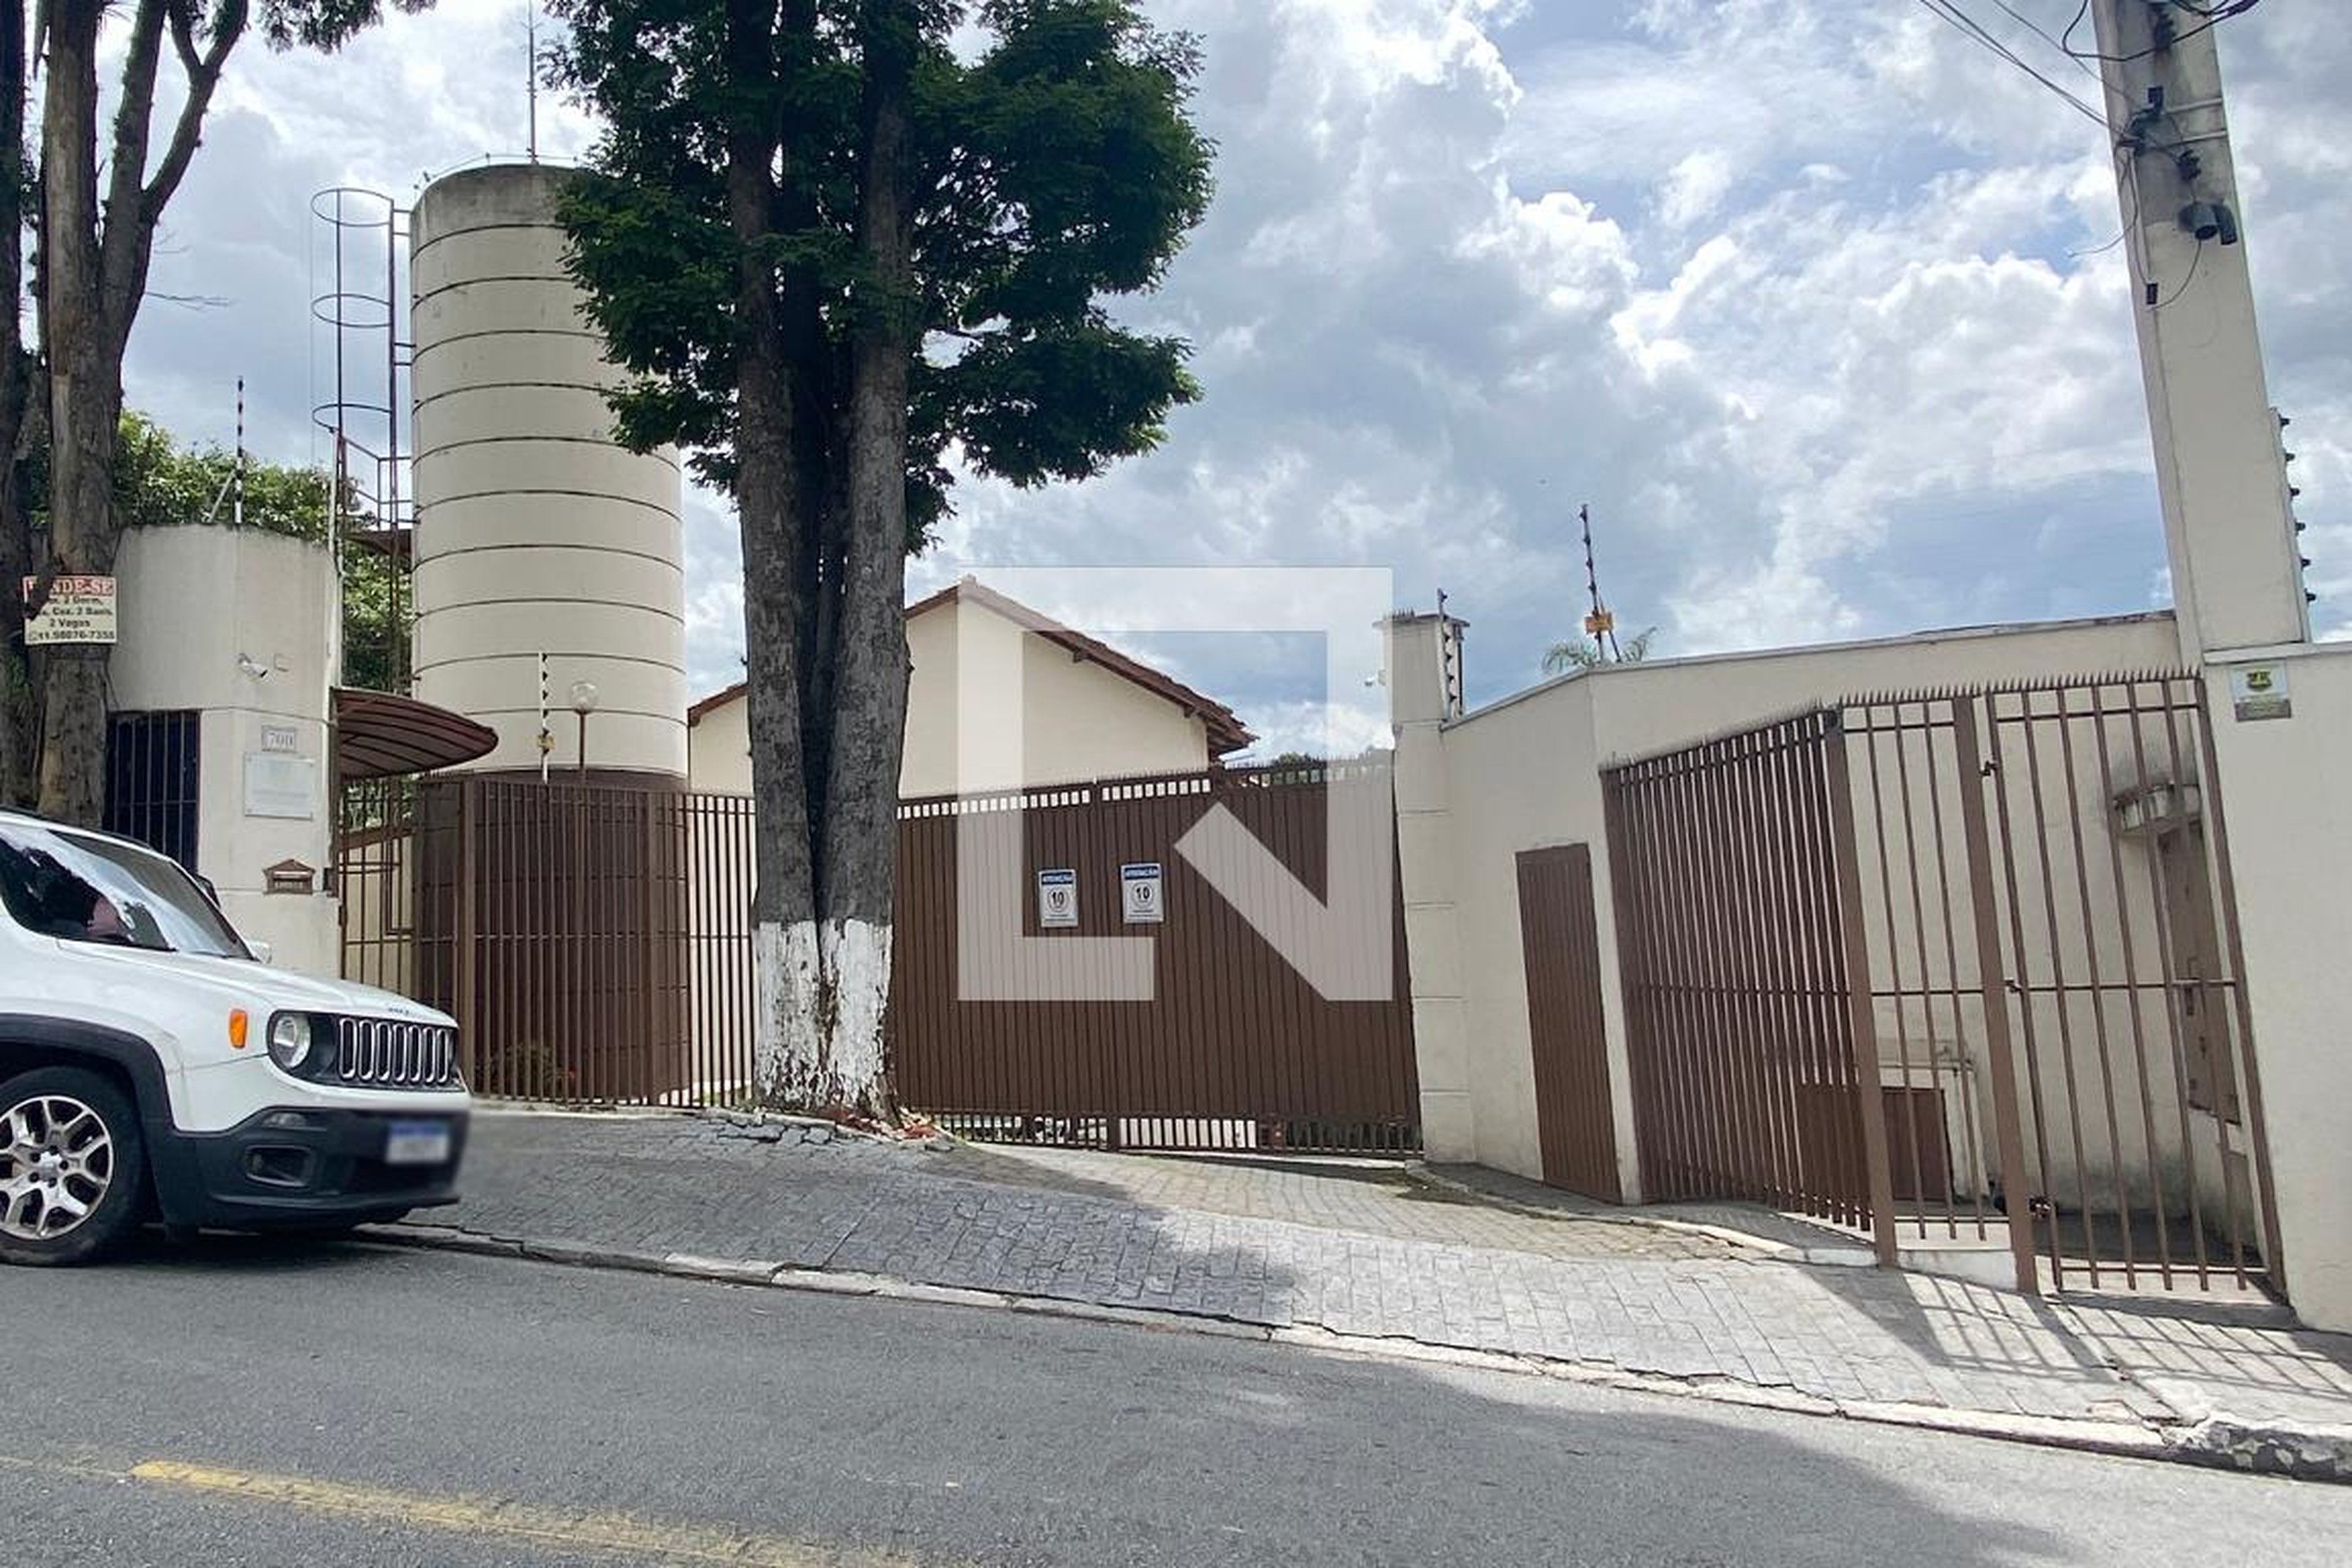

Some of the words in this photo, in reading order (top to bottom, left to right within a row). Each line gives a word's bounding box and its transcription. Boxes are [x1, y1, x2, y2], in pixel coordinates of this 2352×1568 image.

[50, 619, 56, 627] 2
[58, 619, 91, 628] Vagas
[1052, 891, 1065, 905] 10
[1136, 886, 1150, 900] 10
